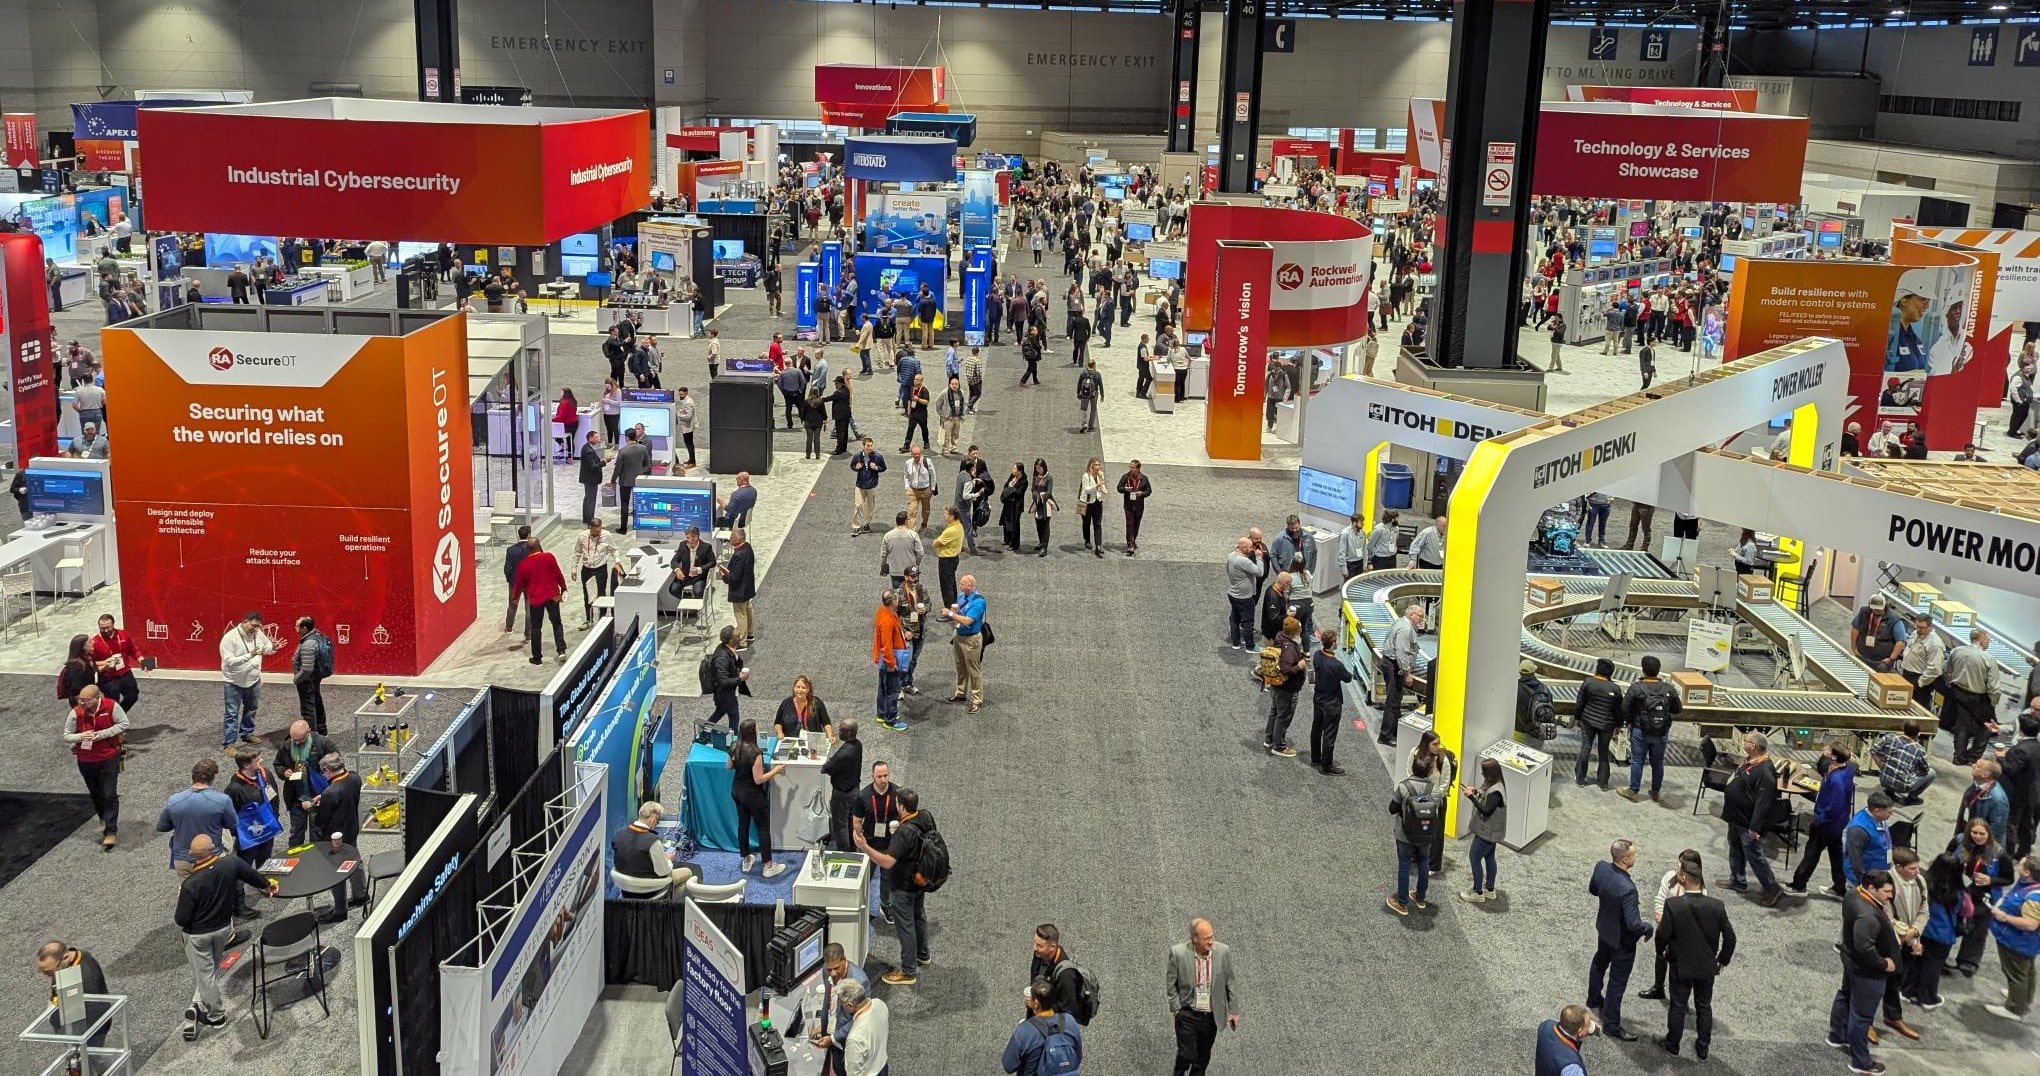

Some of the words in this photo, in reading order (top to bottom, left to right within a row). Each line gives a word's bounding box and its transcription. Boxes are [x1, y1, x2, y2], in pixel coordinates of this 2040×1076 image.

[1242, 5, 1255, 15] 40
[491, 36, 600, 53] EMERGENCY
[608, 40, 648, 54] EXIT
[1027, 53, 1118, 68] EMERGENCY
[1124, 56, 1157, 69] EXIT
[1557, 67, 1573, 78] TO
[1577, 67, 1596, 79] ML
[1601, 68, 1633, 80] KING
[1638, 68, 1677, 81] DRIVE
[854, 83, 892, 92] Innovations
[1771, 82, 1791, 95] EXIT
[1653, 99, 1694, 109] Technology
[1694, 100, 1700, 108] &
[1700, 100, 1732, 108] Services
[892, 127, 945, 137] hammond
[1573, 138, 1663, 160] Technology
[1665, 143, 1678, 157] &
[1682, 144, 1750, 159] Services
[570, 164, 598, 186] Industrial
[597, 156, 633, 182] Cybersecurity
[1618, 162, 1699, 179] Showcase
[227, 165, 320, 187] Industrial
[324, 170, 461, 196] Cybersecurity
[1279, 271, 1300, 283] RA
[1311, 262, 1357, 277] Rockwell
[2004, 265, 2024, 273] with
[1308, 273, 1363, 288] Automation
[1997, 273, 2038, 282] resilience
[1770, 286, 1796, 296] Build
[1797, 288, 1846, 298] resilience
[1847, 289, 1869, 298] with
[1238, 282, 1252, 320] vision
[1760, 297, 1798, 306] modern
[1799, 299, 1835, 308] control
[1836, 300, 1877, 310] systems
[1965, 269, 1984, 338] Automation
[210, 352, 231, 366] RA
[236, 353, 298, 368] SecureOT
[1233, 325, 1249, 397] Tomorrow's
[17, 376, 33, 386] Fortify
[32, 372, 43, 381] Your
[18, 378, 49, 393] Cybersecurity
[1771, 372, 1799, 402] POWER
[1798, 362, 1824, 393] MOLLER
[188, 402, 274, 426] Securing
[276, 406, 325, 423] what
[1384, 405, 1436, 434] ITOH
[172, 426, 205, 444] the
[207, 426, 261, 445] world
[264, 429, 317, 446] relies
[319, 432, 344, 447] on
[432, 366, 452, 530] SecureOT
[1545, 456, 1582, 485] ITOH
[1592, 431, 1637, 467] DENKI
[147, 507, 172, 518] Design
[173, 508, 188, 518] and
[189, 509, 215, 520] deploy
[163, 517, 205, 526] defensible
[158, 525, 205, 535] architecture
[339, 534, 358, 544] Build
[359, 534, 391, 544] resilient
[1888, 514, 1984, 563] POWER
[249, 548, 276, 557] Reduce
[278, 549, 297, 559] your
[345, 543, 386, 553] operations
[245, 556, 270, 565] attack
[271, 557, 301, 566] surface
[559, 700, 570, 718] The
[570, 674, 587, 701] Global
[586, 655, 604, 682] Leader
[397, 889, 435, 941] Machine
[434, 851, 460, 891] Safety
[500, 968, 523, 1001] TRUST
[532, 917, 552, 955] EVERY
[551, 871, 576, 914] ACCESS
[576, 835, 595, 876] POINT
[694, 920, 714, 951] IDEAS
[686, 946, 702, 969] Built
[701, 963, 720, 986] ready
[719, 981, 730, 998] for
[729, 991, 742, 1010] the
[686, 961, 714, 997] factory
[713, 990, 735, 1018] floor.
